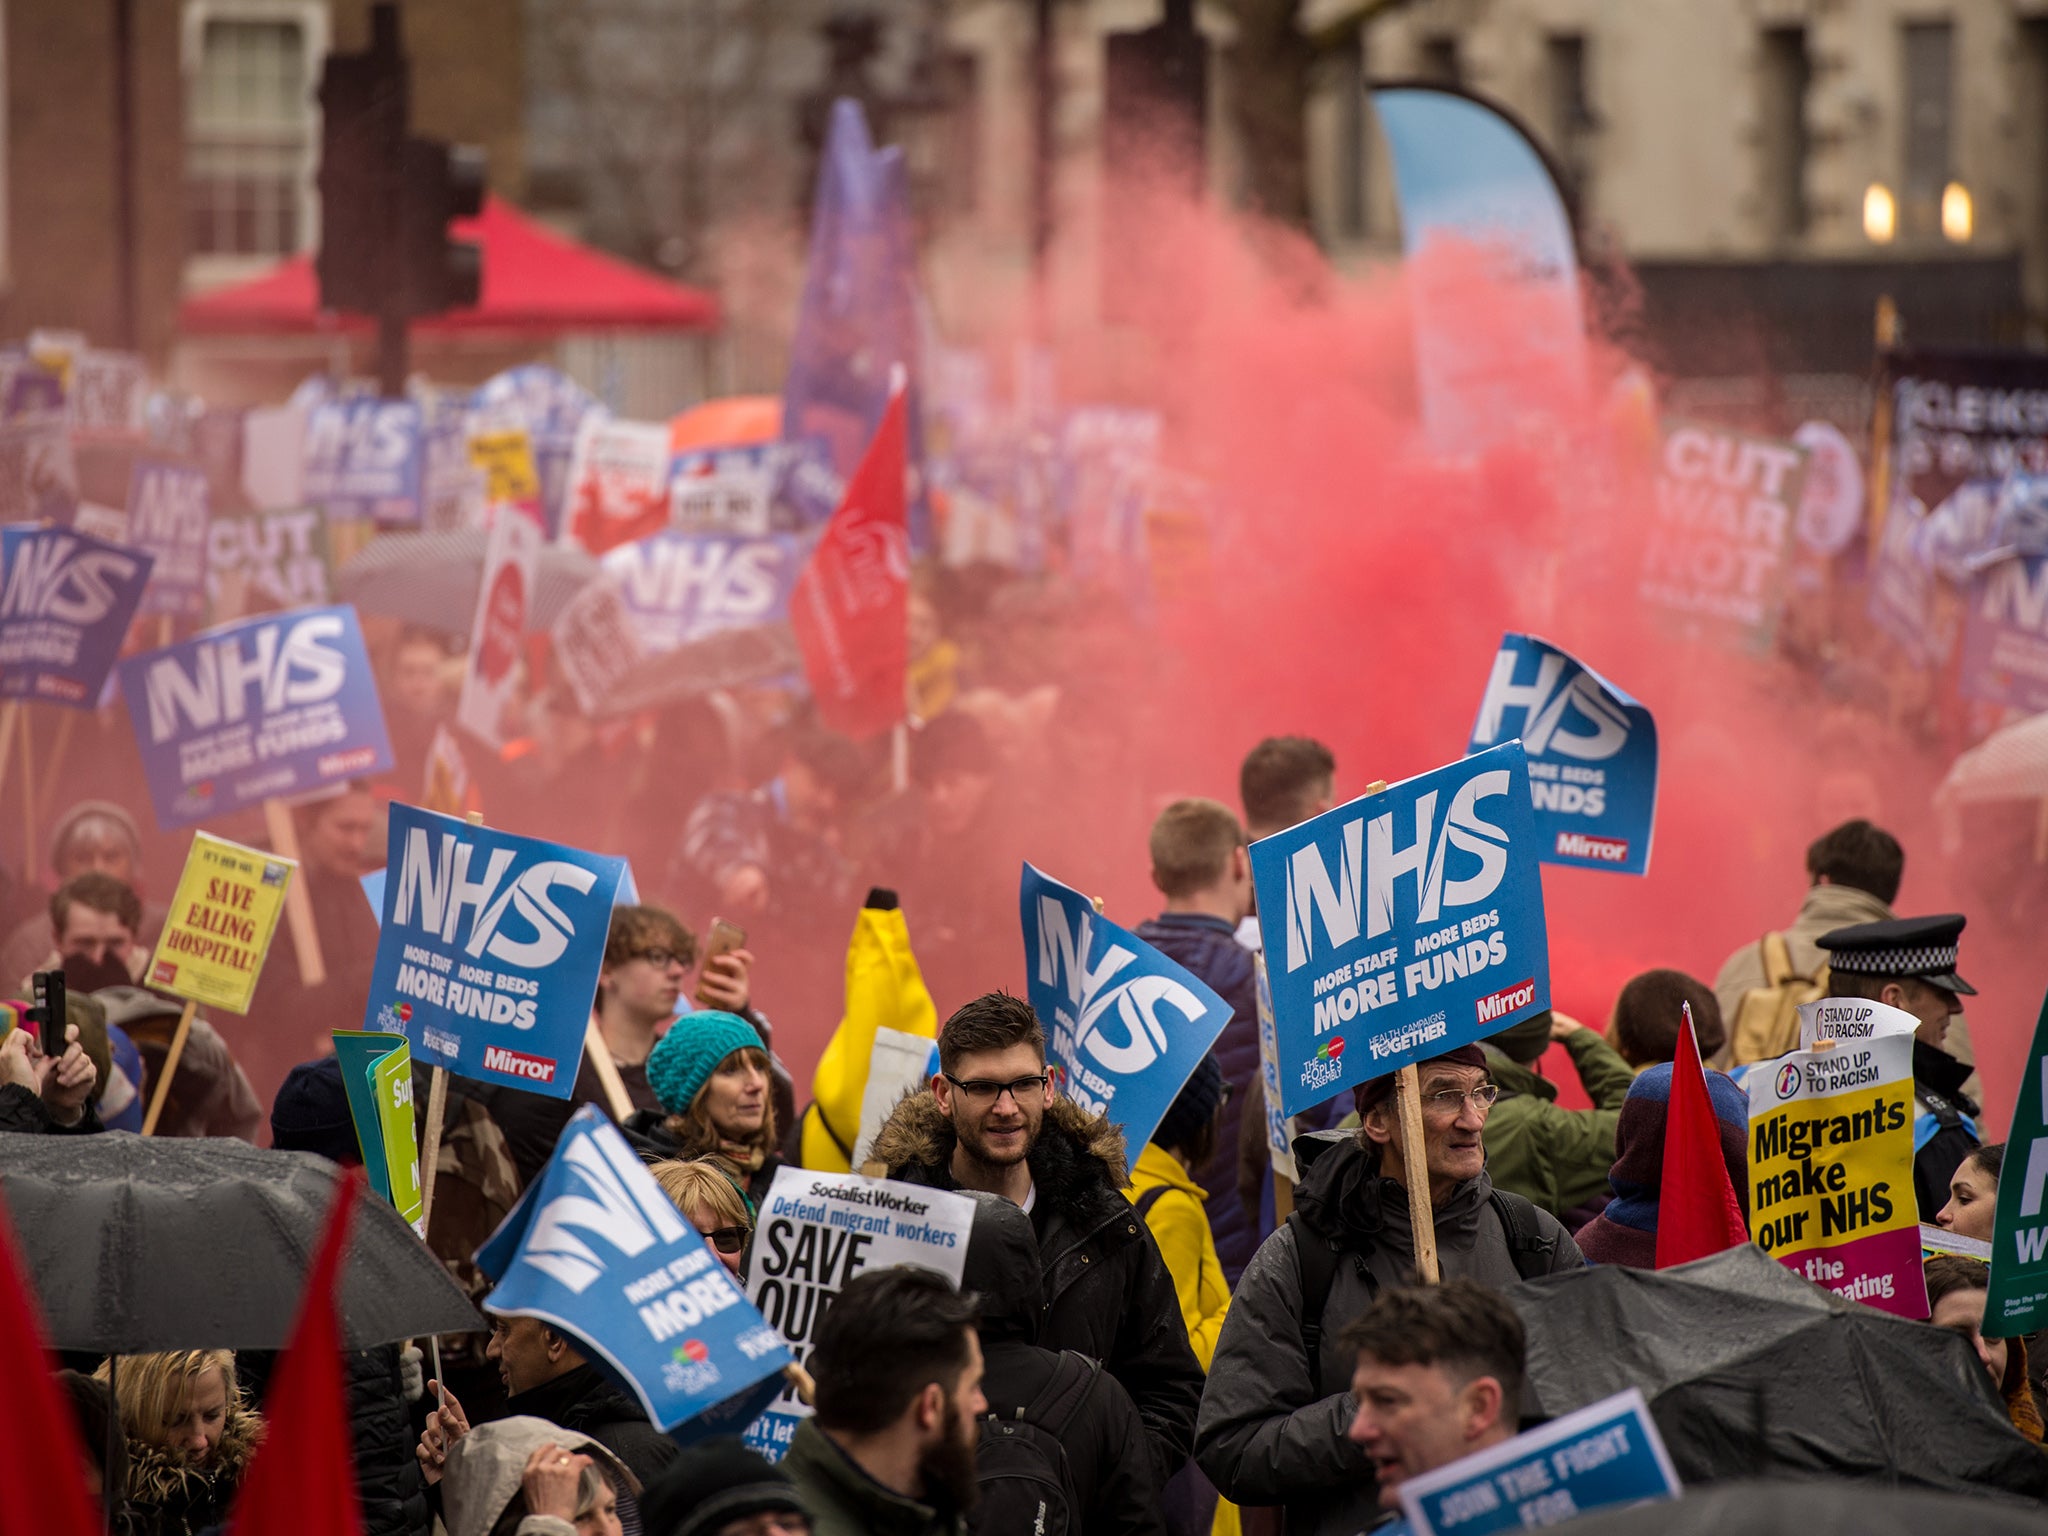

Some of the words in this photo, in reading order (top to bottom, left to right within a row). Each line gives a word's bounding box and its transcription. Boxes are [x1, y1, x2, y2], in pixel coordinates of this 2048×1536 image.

[1665, 427, 1799, 497] CUT
[206, 513, 319, 568] CUT
[616, 536, 783, 613] NHS
[146, 615, 347, 744] NHS
[1473, 649, 1632, 761] HS
[1561, 763, 1605, 785] BEDS
[1530, 780, 1606, 817] NDS
[1557, 833, 1627, 861] Mirror
[206, 876, 257, 912] SAVE
[1286, 769, 1511, 974] NHS
[393, 826, 599, 969] NHS
[186, 902, 256, 944] EALING
[167, 927, 258, 973] HOSPITAL!
[403, 944, 431, 968] MORE
[431, 952, 453, 975] STAFF
[458, 964, 492, 987] MORE
[495, 973, 539, 997] BEDS
[1314, 967, 1352, 997] MORE
[1354, 947, 1399, 978] STAFF
[1415, 928, 1461, 956] MORE
[1463, 909, 1500, 940] BEDS
[395, 963, 446, 1007] MORE
[447, 980, 538, 1031] FUNDS
[1037, 893, 1208, 1075] NHS
[1314, 972, 1399, 1037] MORE
[1404, 930, 1508, 998] FUNDS
[1477, 983, 1534, 1024] Mirror
[1369, 1028, 1401, 1046] HEALTH
[1402, 1010, 1447, 1035] CAMPAIGNS
[1824, 1007, 1852, 1022] STAND
[1854, 1007, 1873, 1021] UP
[1824, 1023, 1835, 1038] TO
[1835, 1023, 1874, 1038] RACISM
[483, 1046, 555, 1081] Mirror
[1303, 1056, 1320, 1072] THE
[1370, 1021, 1448, 1061] TOGETHER
[1082, 1068, 1116, 1101] BEDS
[1311, 1068, 1342, 1092] ASSEMBLY
[1806, 1055, 1850, 1078] STAND
[1852, 1051, 1872, 1069] UP
[1807, 1077, 1826, 1094] TO
[1830, 1067, 1880, 1091] RACISM
[1754, 1098, 1906, 1165] Migrants
[808, 1182, 873, 1207] Socialist
[874, 1190, 930, 1216] Worker
[1757, 1159, 1847, 1211] make
[771, 1196, 827, 1224] Defend
[829, 1208, 890, 1236] migrant
[894, 1221, 957, 1248] workers
[1758, 1208, 1809, 1252] our
[1820, 1182, 1894, 1238] NHS
[762, 1219, 873, 1292] SAVE
[1806, 1257, 1844, 1282] the
[637, 1270, 741, 1343] MORE
[773, 1420, 794, 1443] let
[1440, 1480, 1500, 1528] JOIN
[1497, 1459, 1553, 1501] THE
[1552, 1423, 1631, 1481] FIGHT
